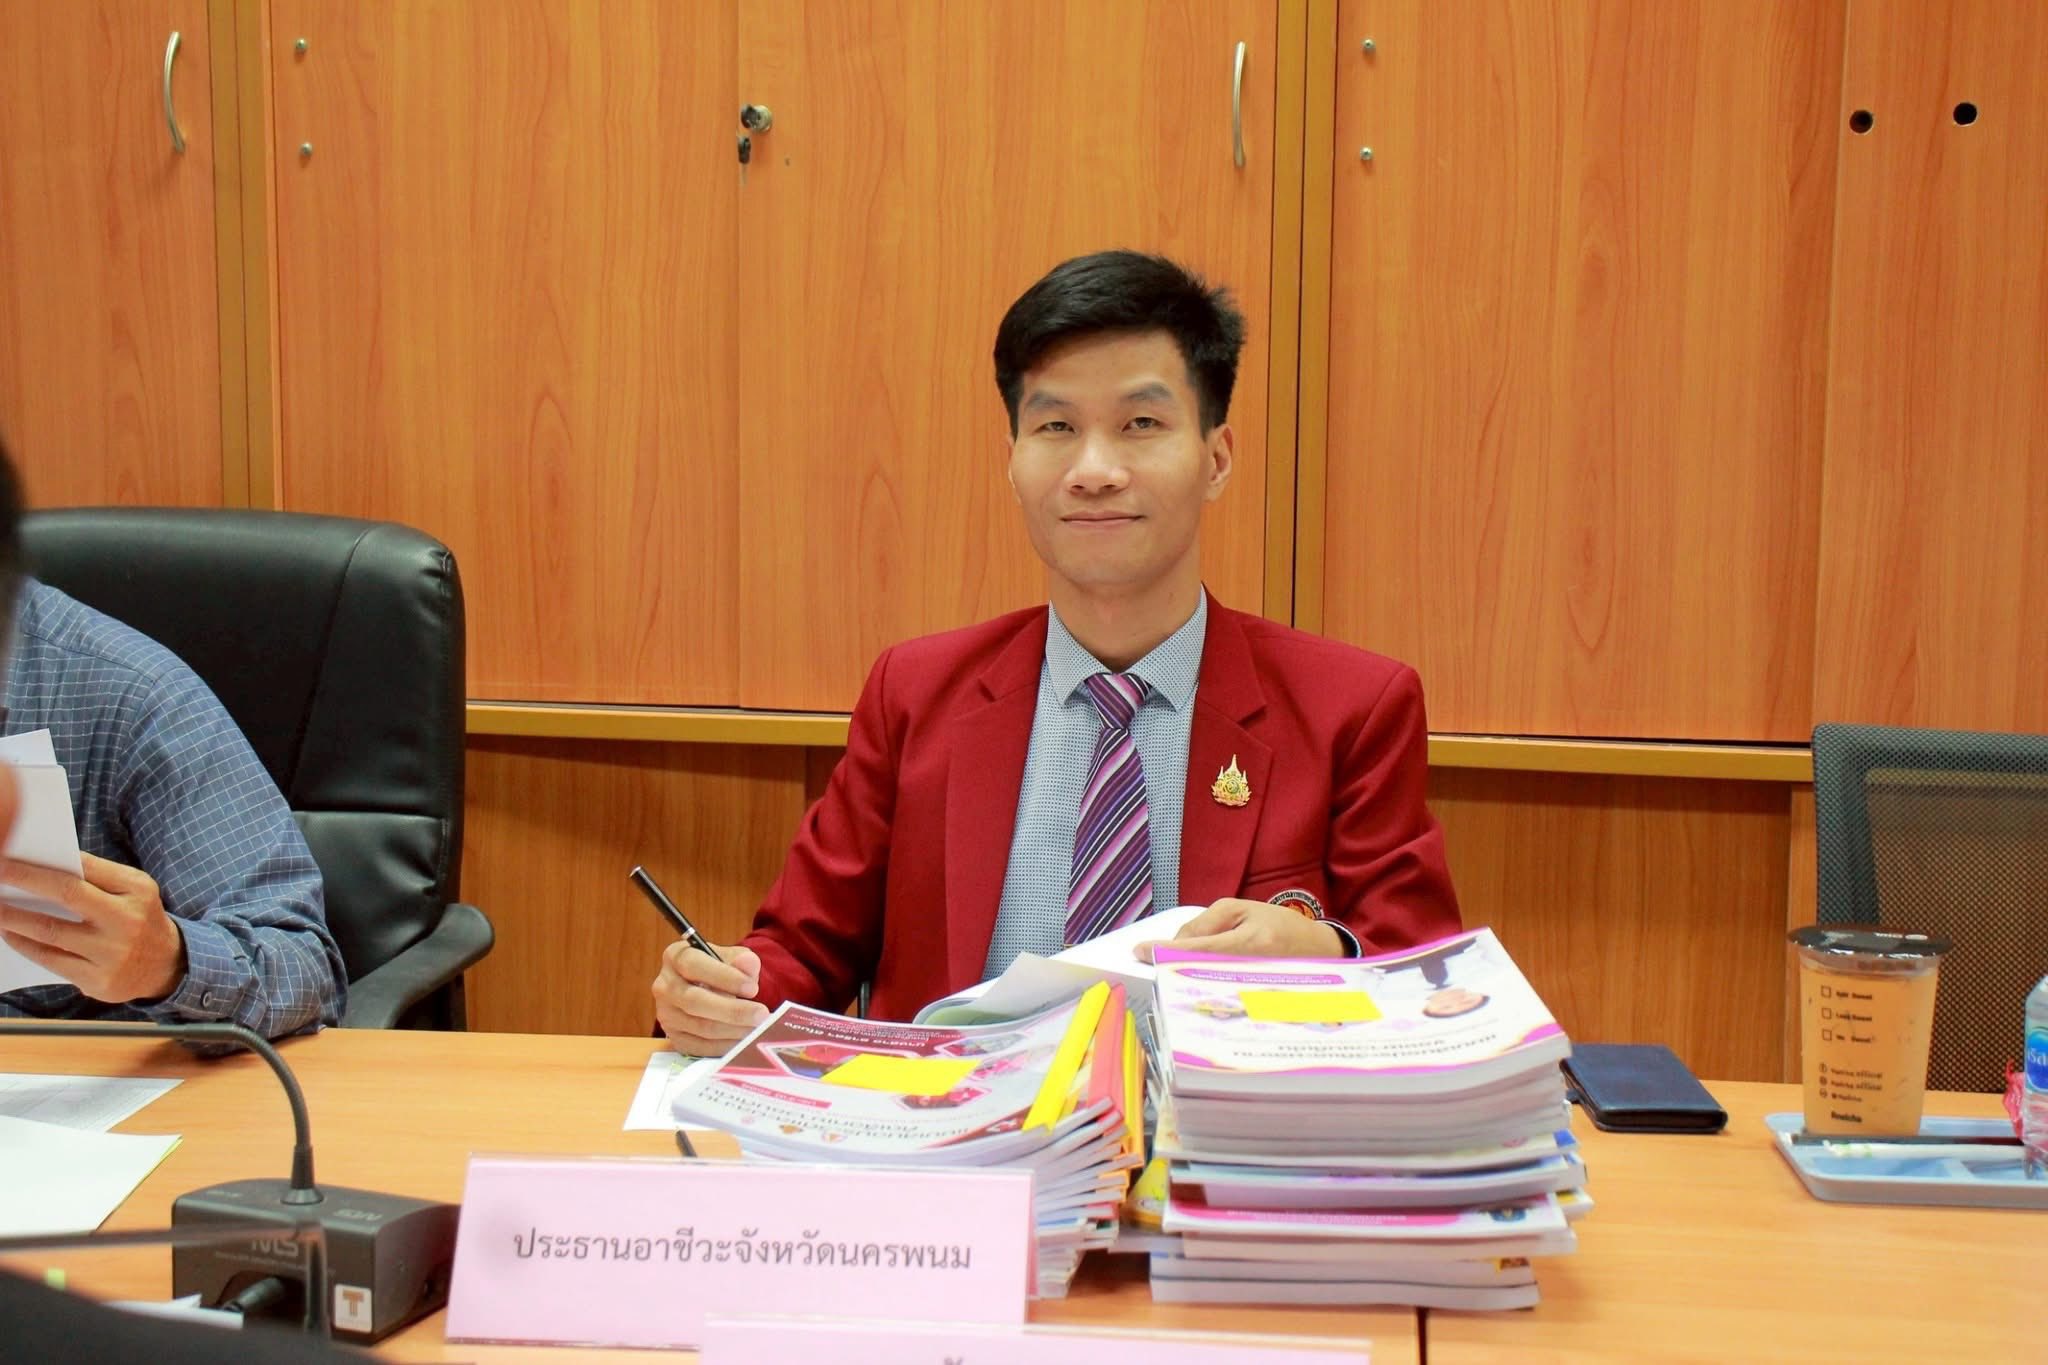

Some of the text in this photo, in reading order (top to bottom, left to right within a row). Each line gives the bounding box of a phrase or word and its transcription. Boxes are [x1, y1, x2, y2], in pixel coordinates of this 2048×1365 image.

[513, 1227, 973, 1269] ประธานอาชีวะจังหวัดนครพนม
